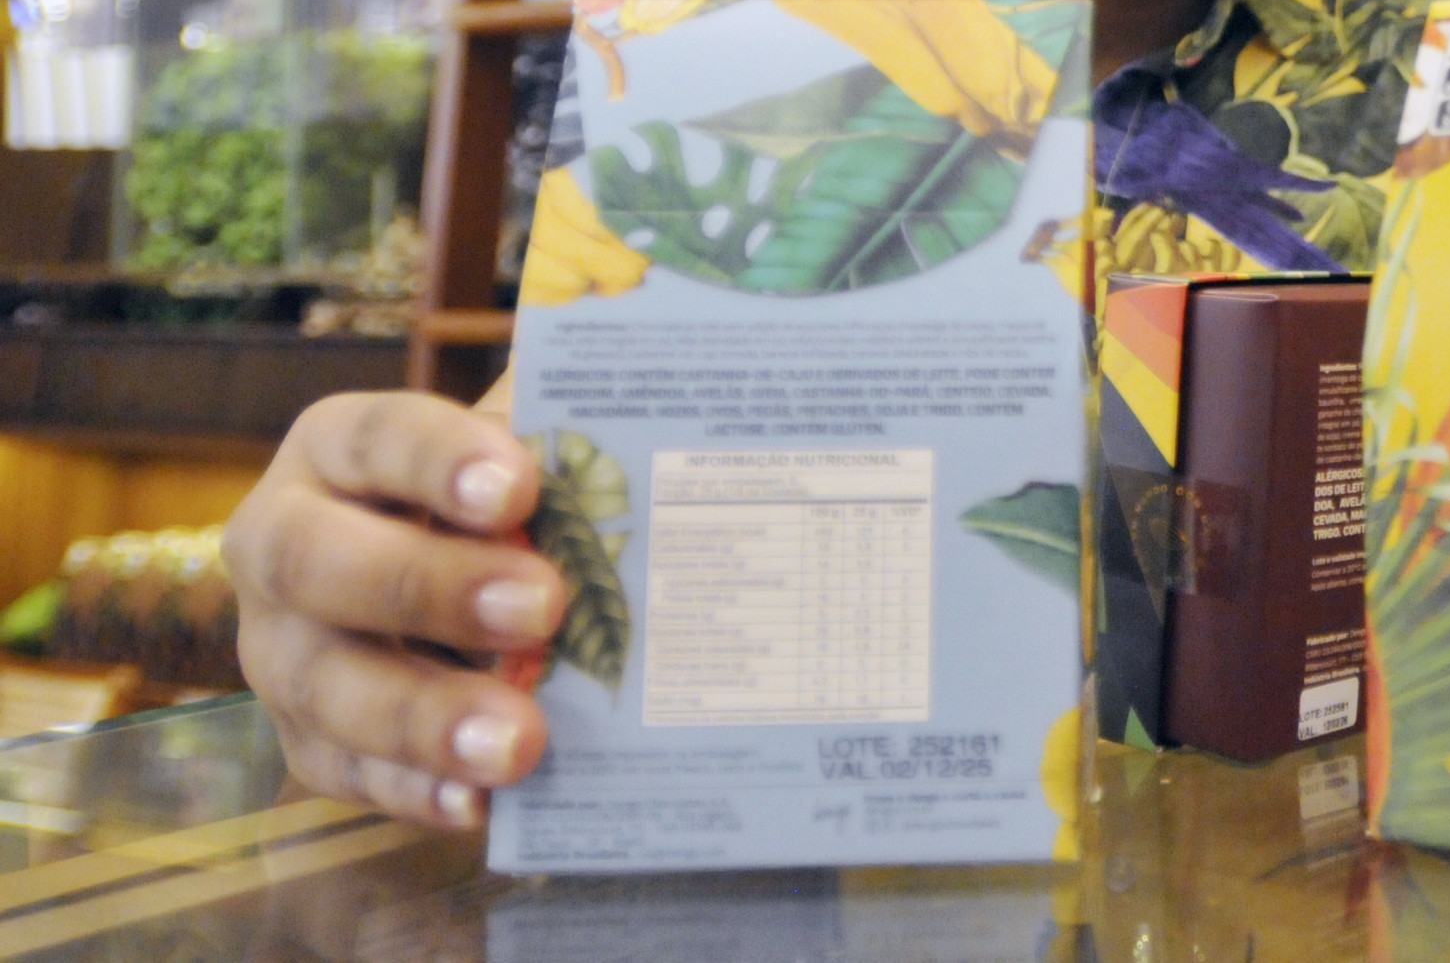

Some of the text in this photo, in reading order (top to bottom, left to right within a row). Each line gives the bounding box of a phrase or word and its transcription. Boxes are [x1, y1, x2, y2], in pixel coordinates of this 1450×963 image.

[1334, 484, 1346, 495] DE
[1347, 481, 1365, 494] LEIT
[1342, 524, 1366, 536] CONT
